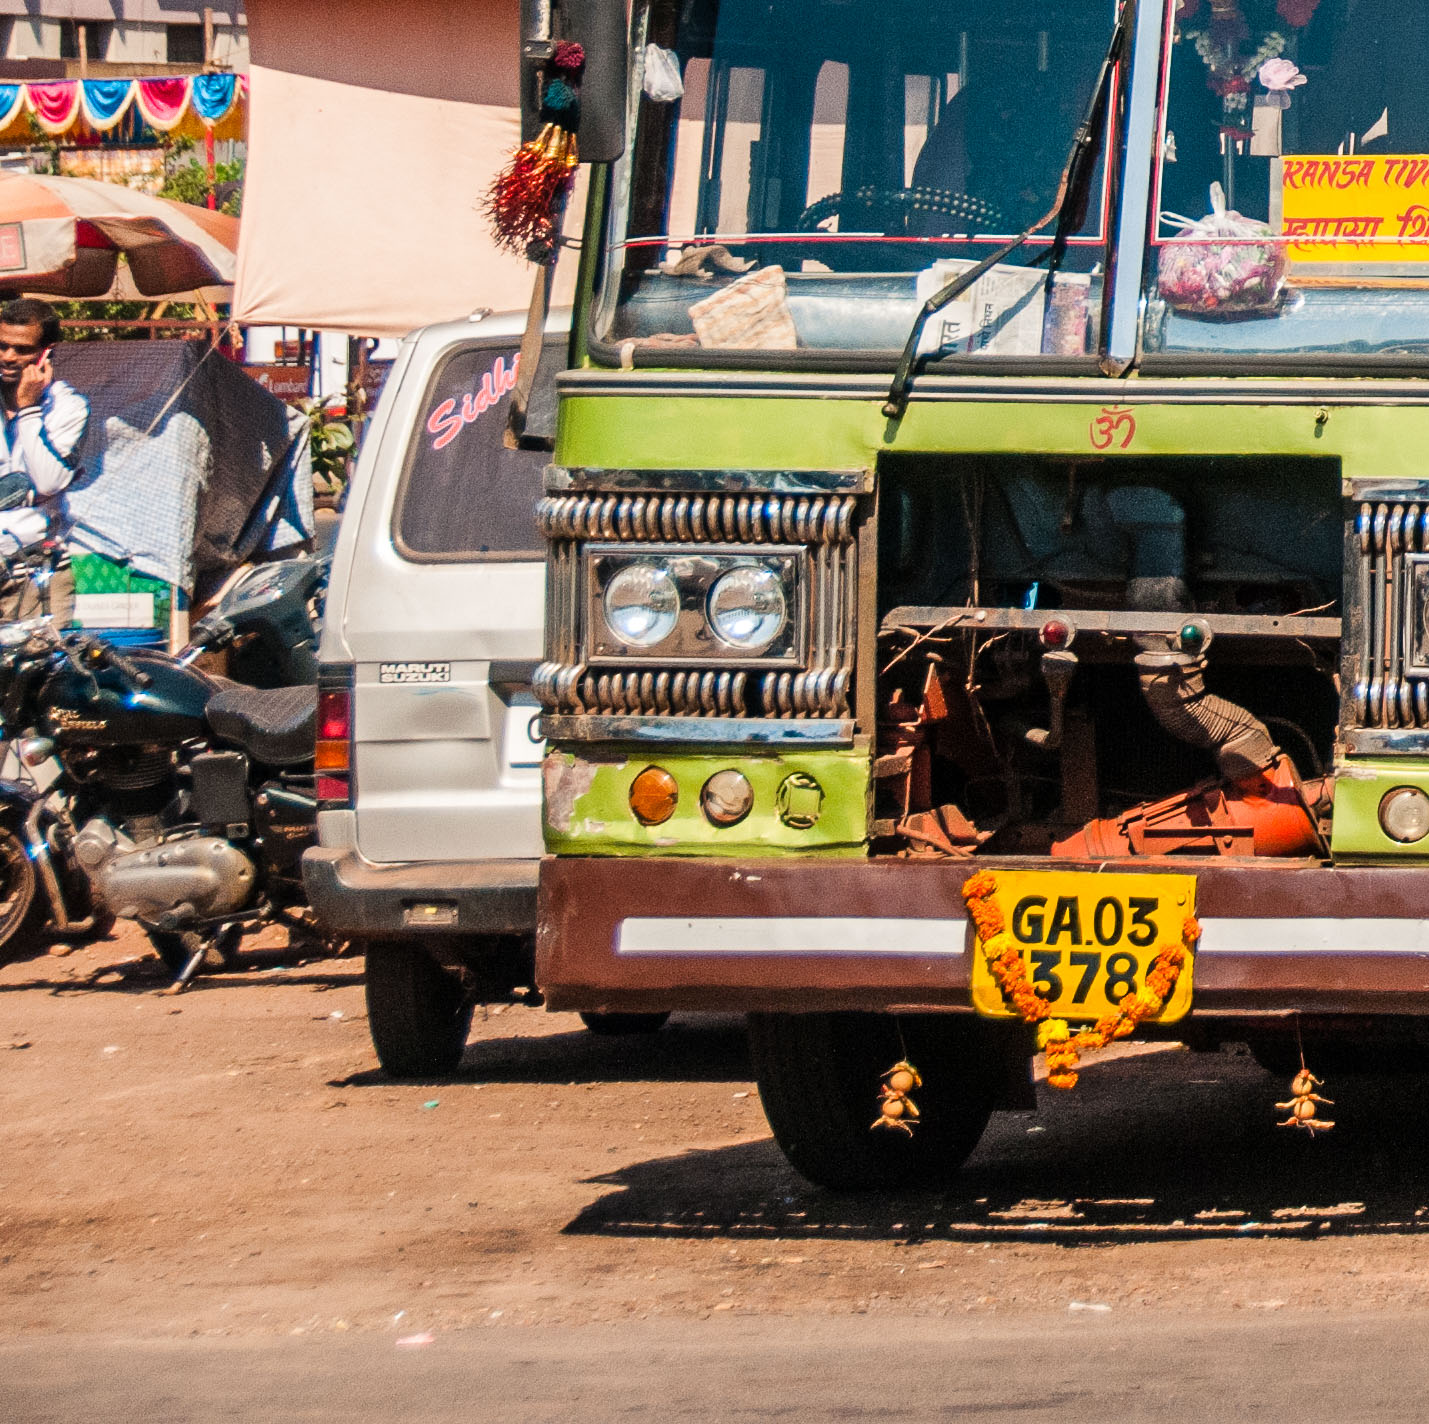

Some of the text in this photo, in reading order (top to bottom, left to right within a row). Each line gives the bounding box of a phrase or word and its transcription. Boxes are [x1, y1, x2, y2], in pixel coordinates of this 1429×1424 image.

[1281, 159, 1376, 190] KANSA
[381, 663, 450, 674] MARUTI
[381, 672, 450, 683] SUZUKI
